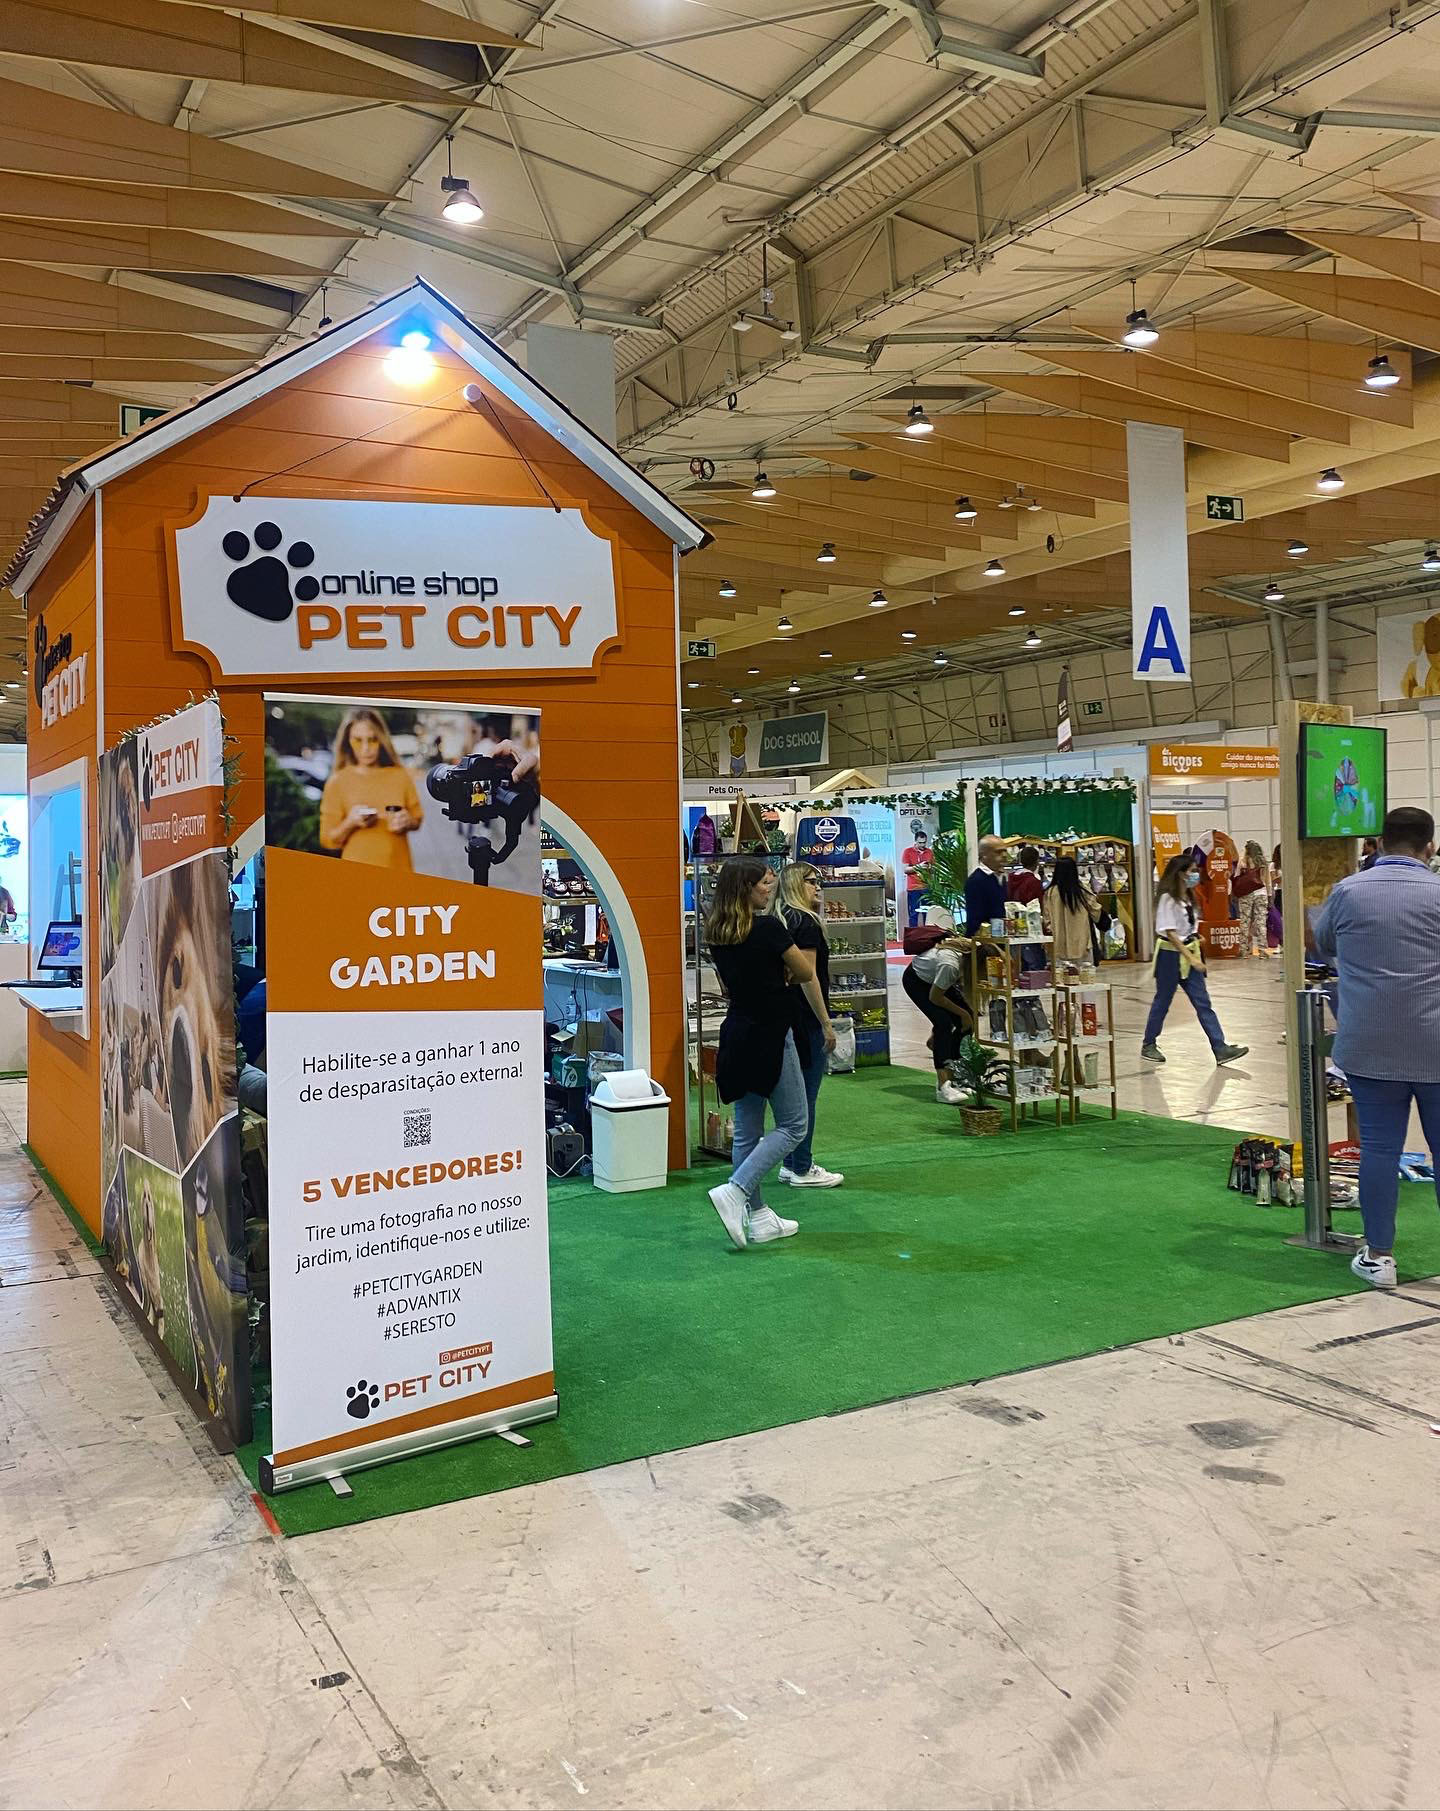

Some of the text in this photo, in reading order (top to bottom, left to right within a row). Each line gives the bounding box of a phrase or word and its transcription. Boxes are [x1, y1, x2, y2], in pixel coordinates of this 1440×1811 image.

[322, 570, 498, 601] online shop
[297, 605, 582, 650] PET CITY
[1137, 606, 1186, 674] A
[42, 652, 88, 730] PET CITY
[764, 730, 821, 750] DOG SCHOOL
[154, 738, 200, 789] PET CITY
[709, 786, 743, 794] Pets One
[368, 904, 459, 938] CITY
[329, 949, 496, 989] GARDEN
[302, 1038, 520, 1075] Habilite-se a ganhar 1 ano
[300, 1062, 523, 1103] de desparasitação externa!
[303, 1150, 523, 1203] 5 VENCEDORES!
[305, 1195, 522, 1242] Tire uma fotografia no nosso
[295, 1216, 531, 1274] jardim, identifique-nos e utilize:
[352, 1260, 483, 1299] #PETCITYGARDEN
[377, 1287, 461, 1318] #ADVANTIX
[383, 1312, 456, 1341] #SERESTO
[452, 1344, 490, 1360] @PETCITYPT
[384, 1360, 491, 1402] PET CITY
